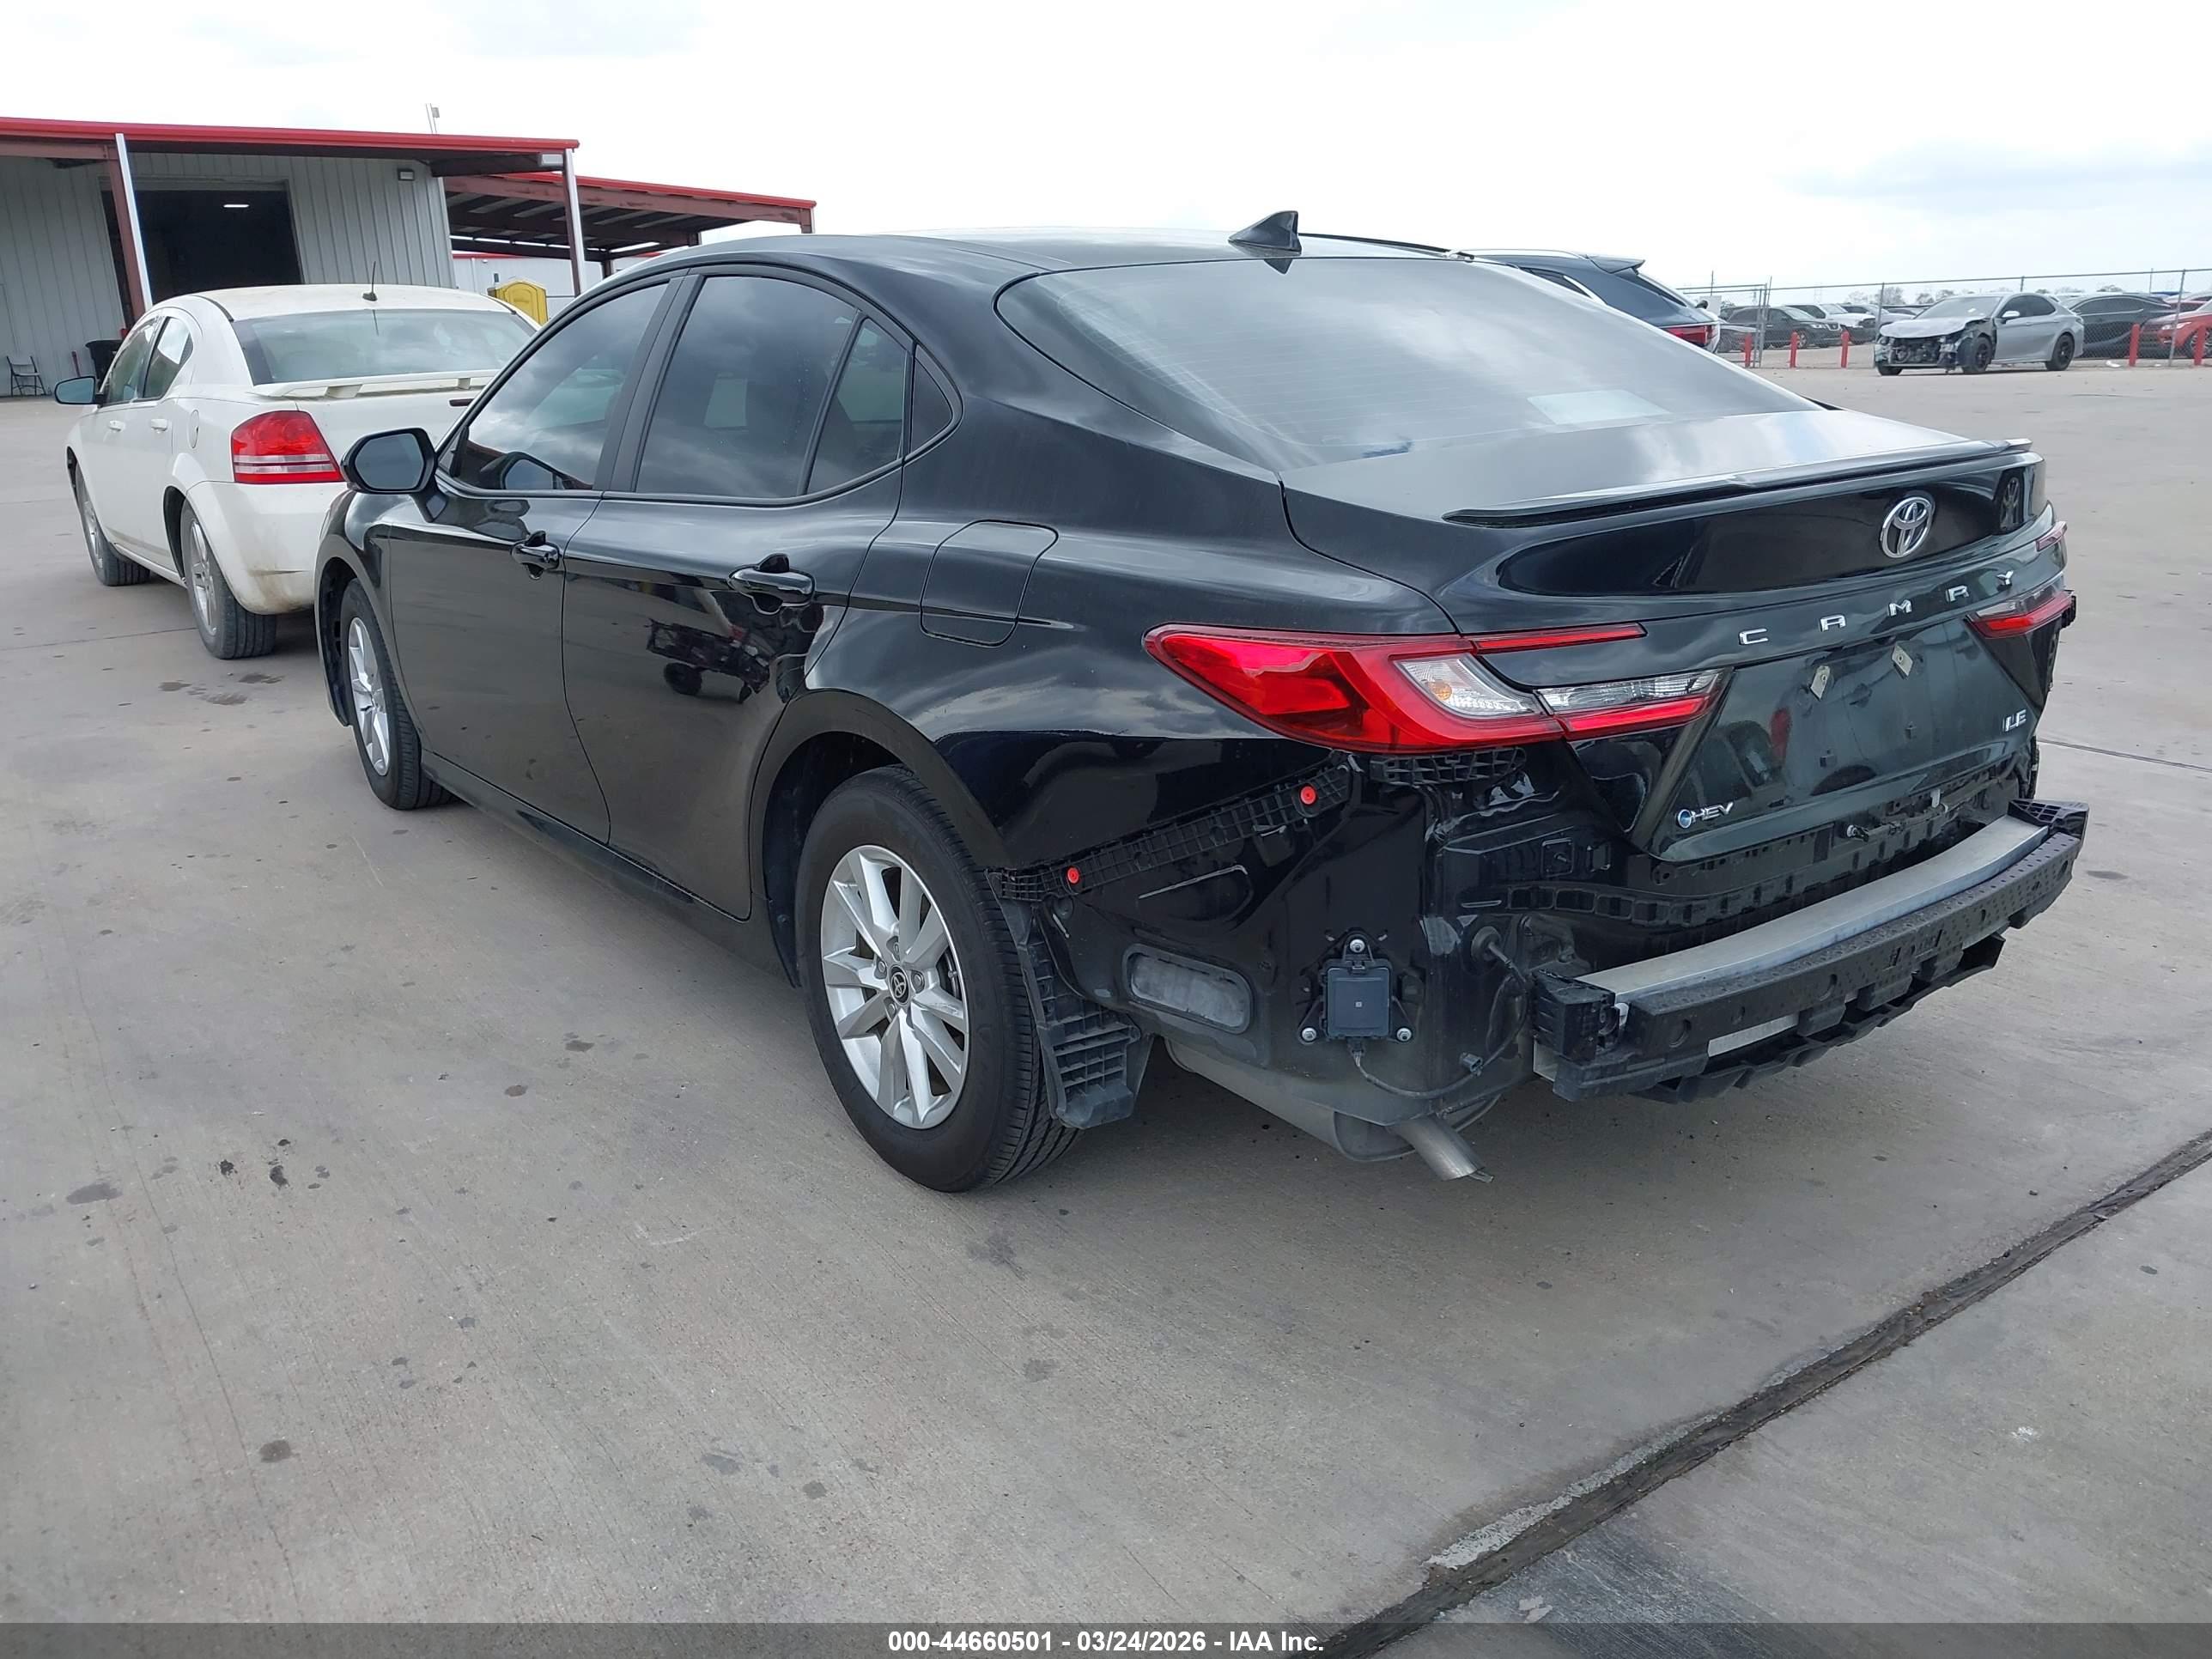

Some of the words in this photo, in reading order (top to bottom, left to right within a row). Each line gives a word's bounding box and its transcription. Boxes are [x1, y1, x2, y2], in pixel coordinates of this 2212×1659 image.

[1739, 570, 2014, 645] CAMRY
[2003, 708, 2027, 732] LE
[1690, 801, 1734, 823] HEV
